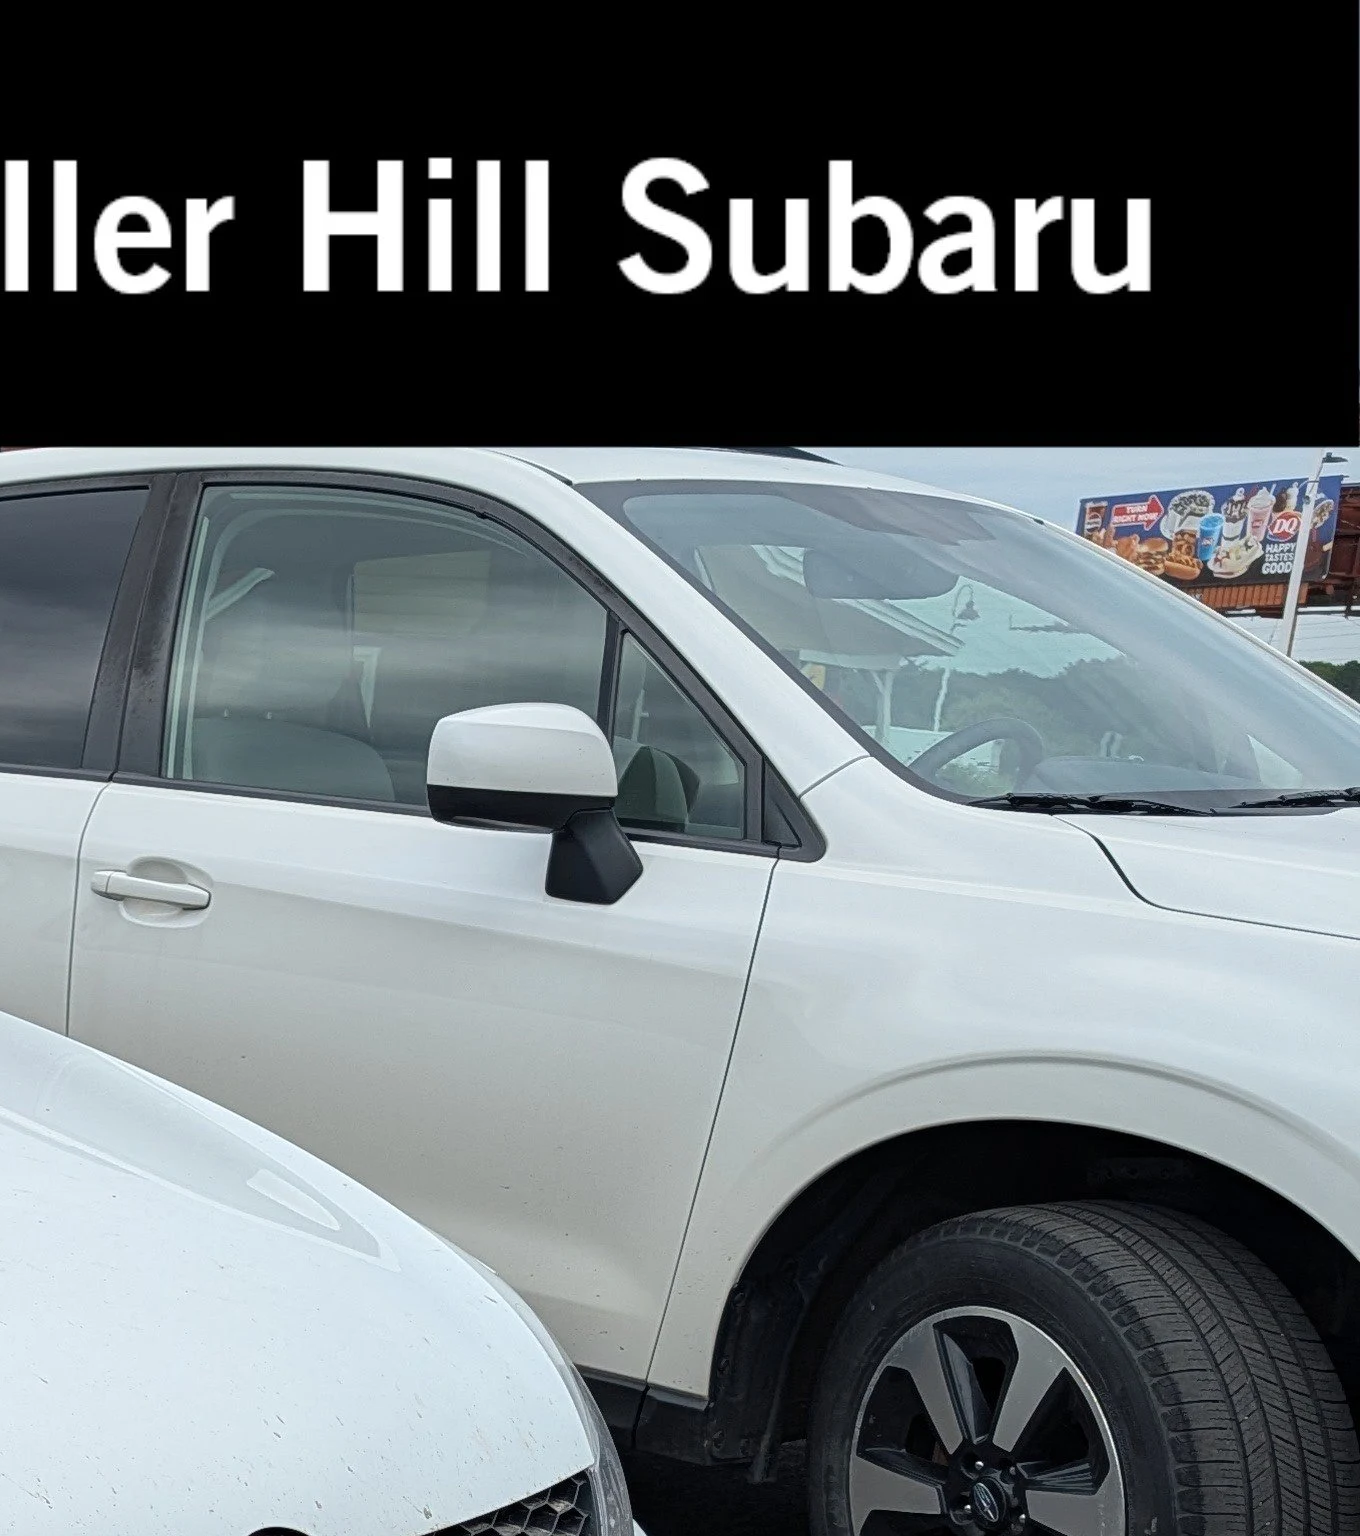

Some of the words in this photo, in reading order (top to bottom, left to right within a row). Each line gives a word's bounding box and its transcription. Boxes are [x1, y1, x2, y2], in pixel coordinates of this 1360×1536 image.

[1272, 518, 1298, 535] DQ
[1265, 542, 1296, 554] HAPPY
[1265, 552, 1295, 562] TASTES
[1261, 561, 1292, 575] GOOD
